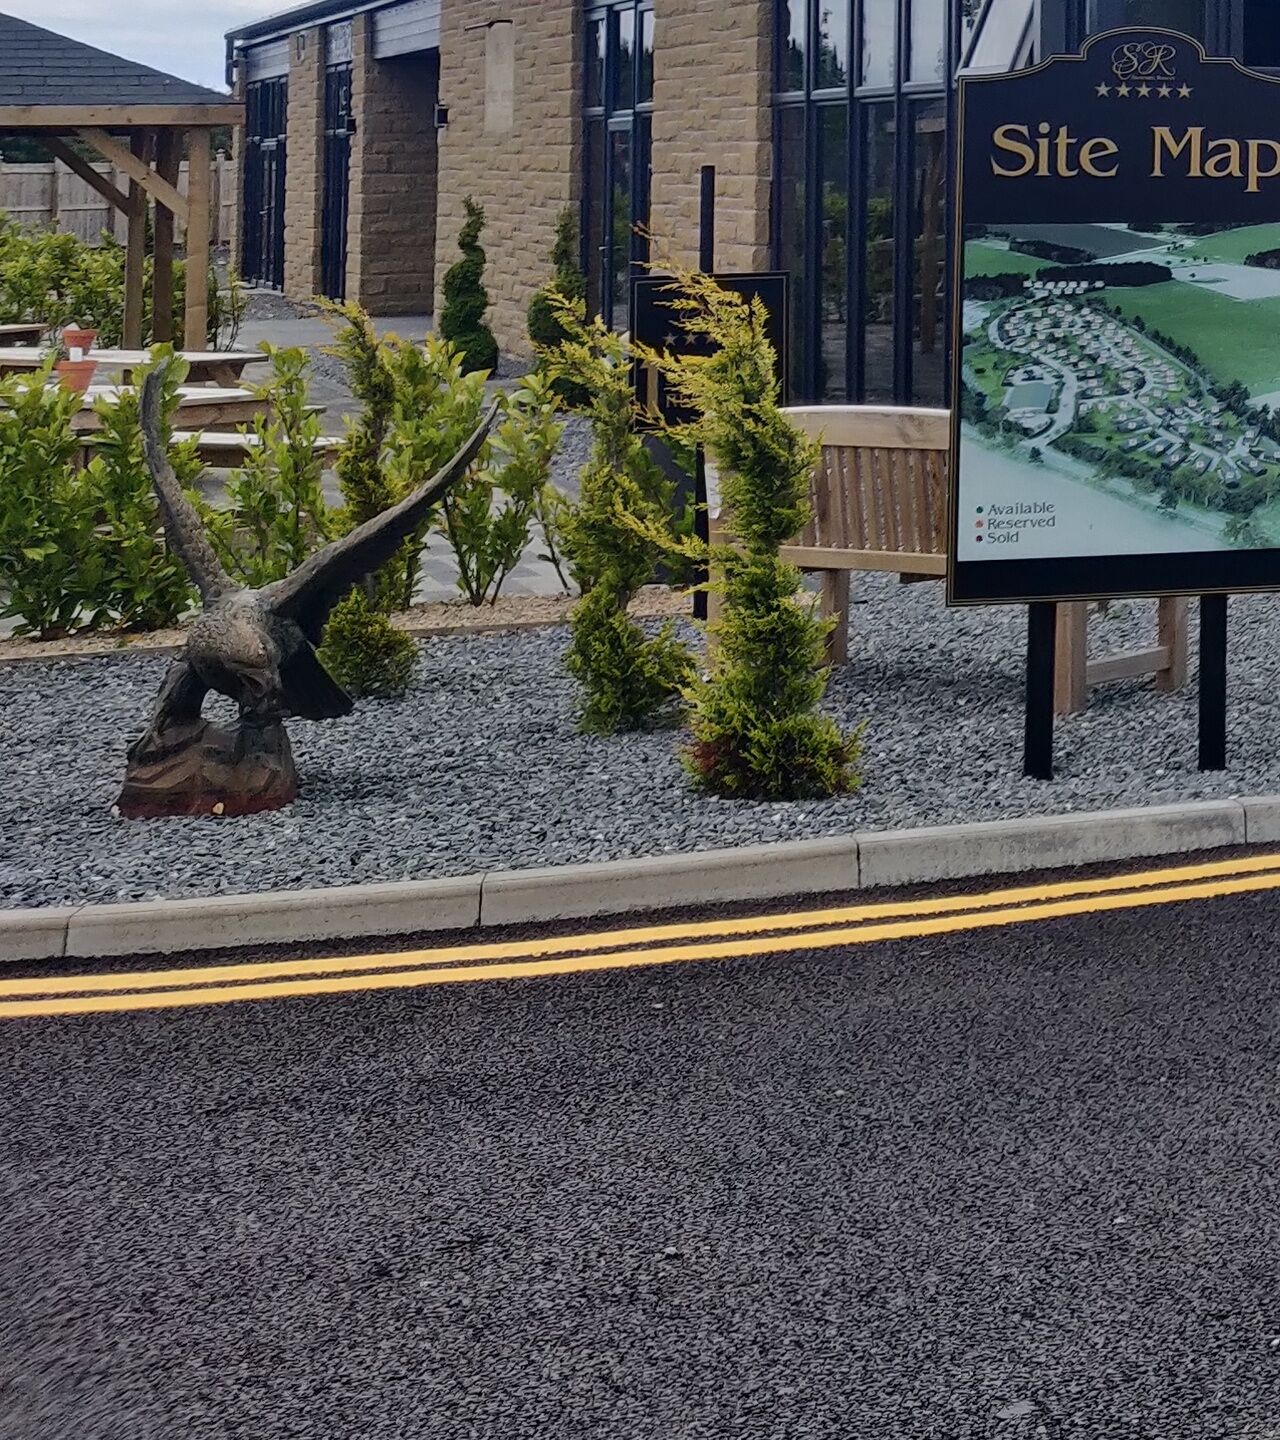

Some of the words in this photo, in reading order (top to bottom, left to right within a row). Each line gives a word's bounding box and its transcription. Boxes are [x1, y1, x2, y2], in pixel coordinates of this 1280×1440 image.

[990, 121, 1120, 178] Site
[987, 501, 1056, 516] Available
[987, 515, 1056, 530] Reserved
[987, 531, 1019, 544] Sold
